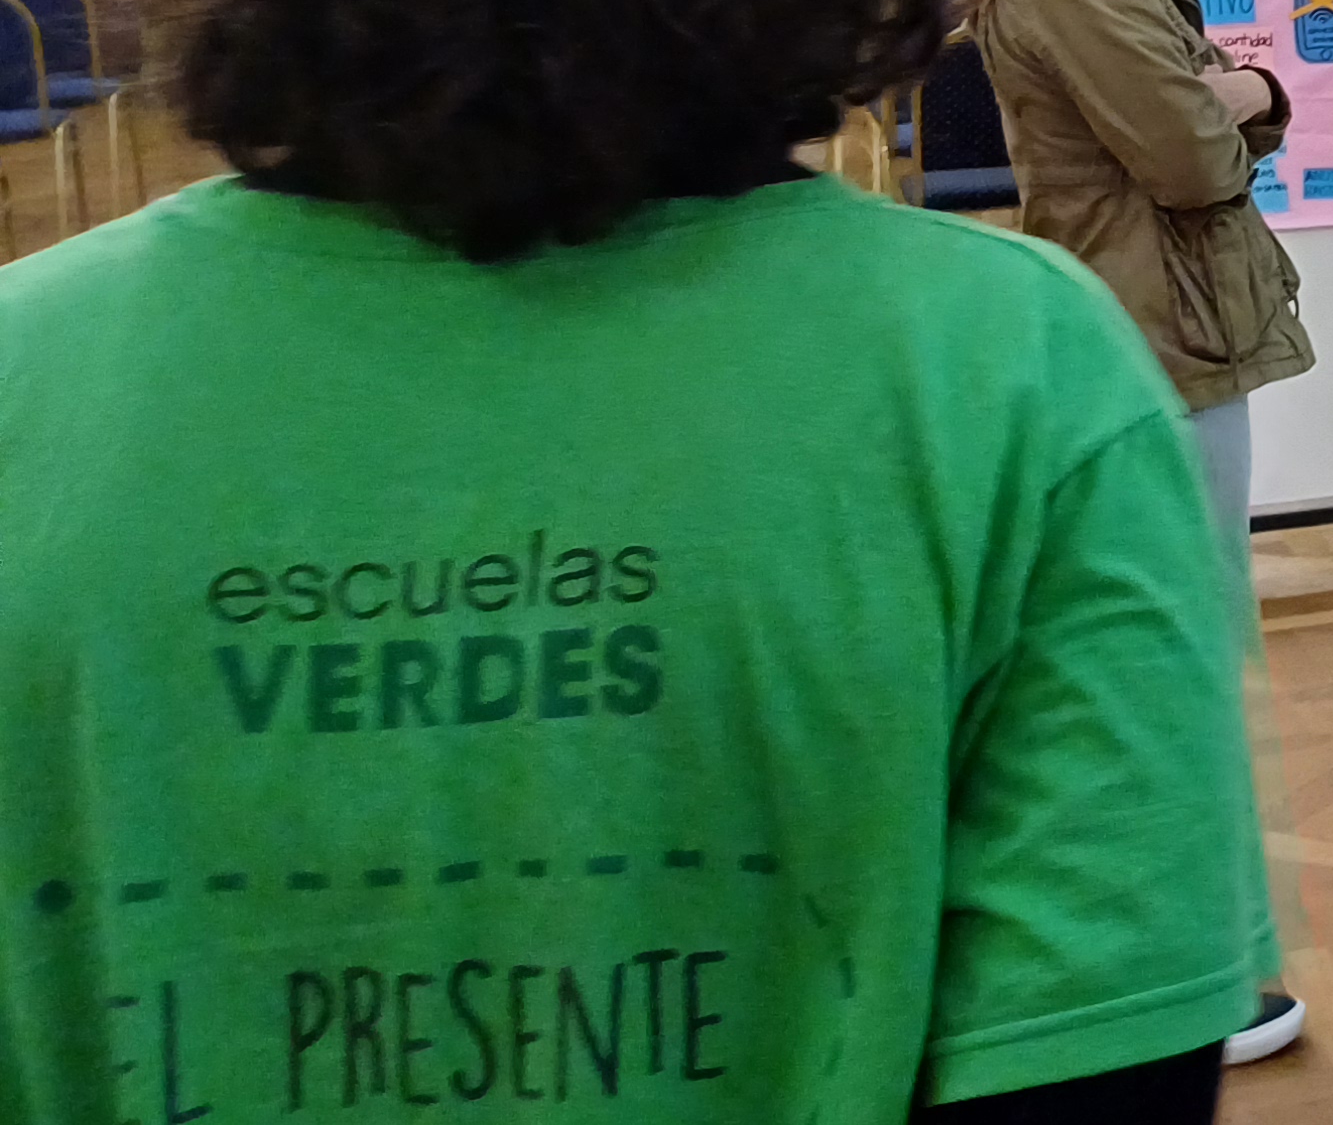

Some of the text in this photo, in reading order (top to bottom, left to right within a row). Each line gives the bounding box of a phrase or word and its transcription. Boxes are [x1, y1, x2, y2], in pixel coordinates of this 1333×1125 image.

[209, 529, 659, 623] escuelas
[214, 625, 664, 734] VERDES
[283, 949, 728, 1113] PRESENTE
